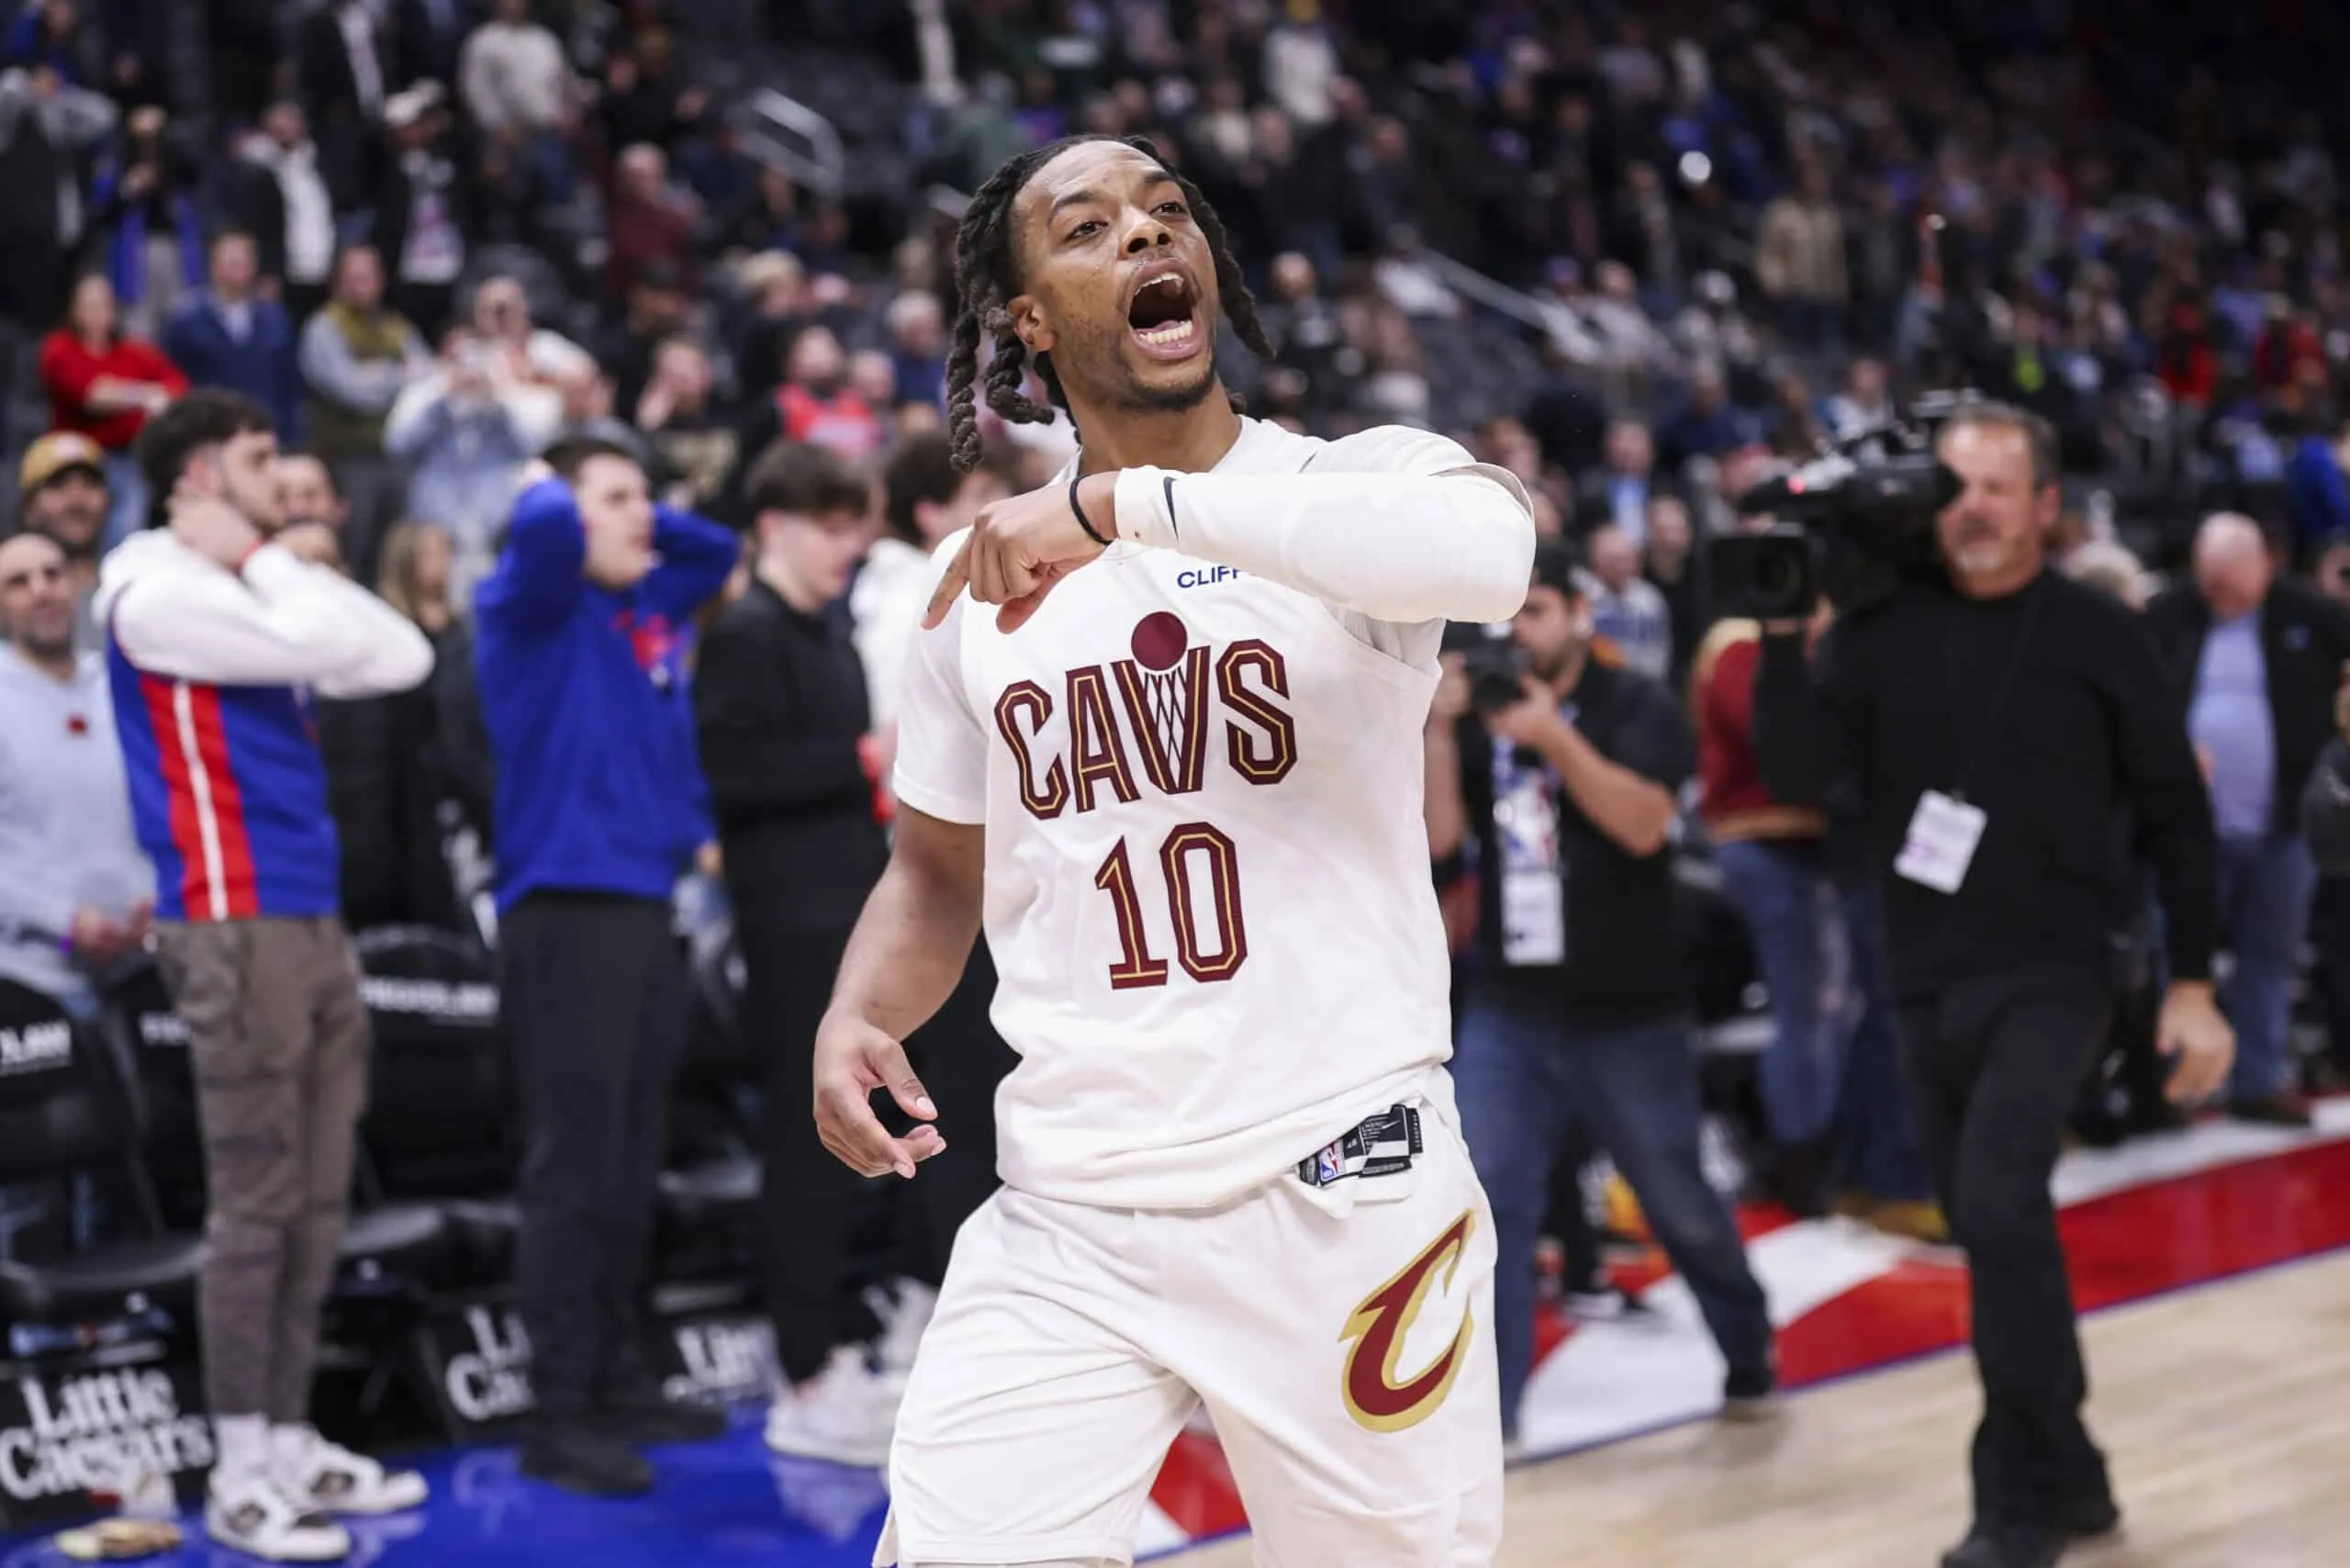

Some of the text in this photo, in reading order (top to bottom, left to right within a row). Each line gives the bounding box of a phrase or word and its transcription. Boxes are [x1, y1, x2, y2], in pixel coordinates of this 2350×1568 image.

[994, 637, 1298, 821] CAVS
[1095, 822, 1248, 990] 10
[22, 1368, 176, 1439] Little
